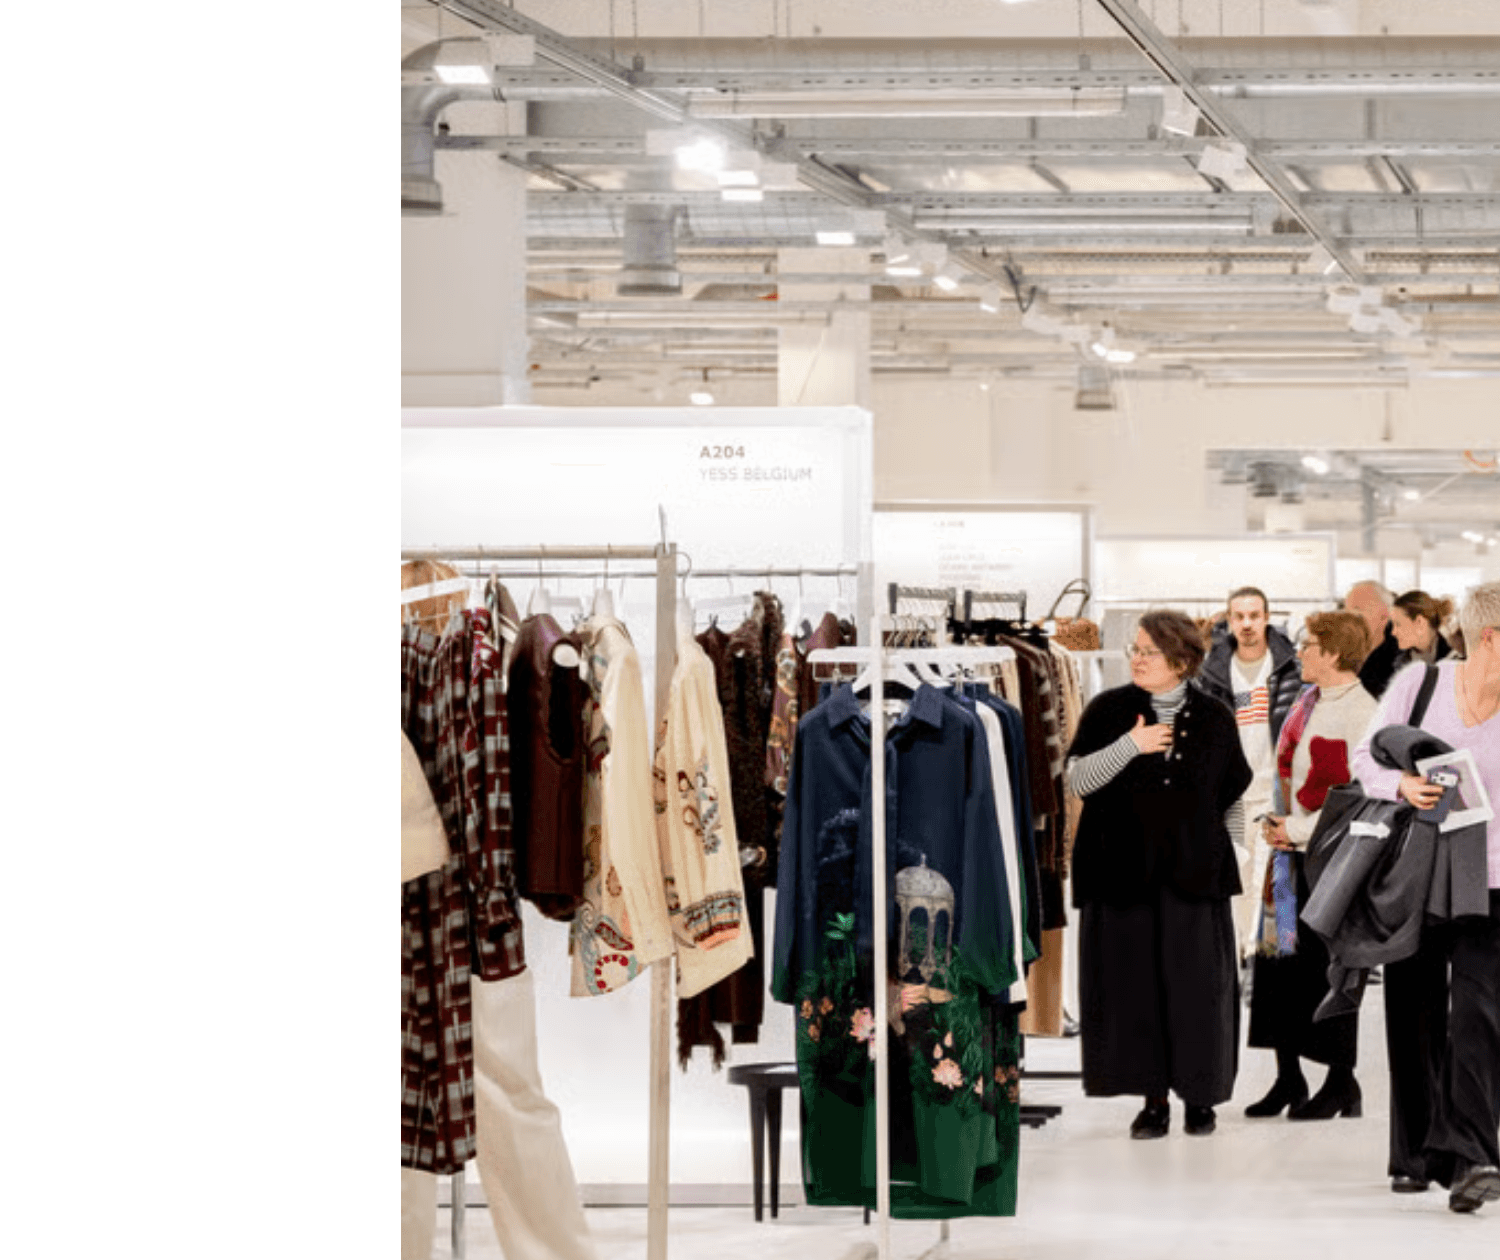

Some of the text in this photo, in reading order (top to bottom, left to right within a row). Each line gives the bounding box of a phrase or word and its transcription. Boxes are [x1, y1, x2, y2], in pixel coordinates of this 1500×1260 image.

[700, 445, 745, 459] A204
[700, 466, 812, 481] YESS BELGIUM
